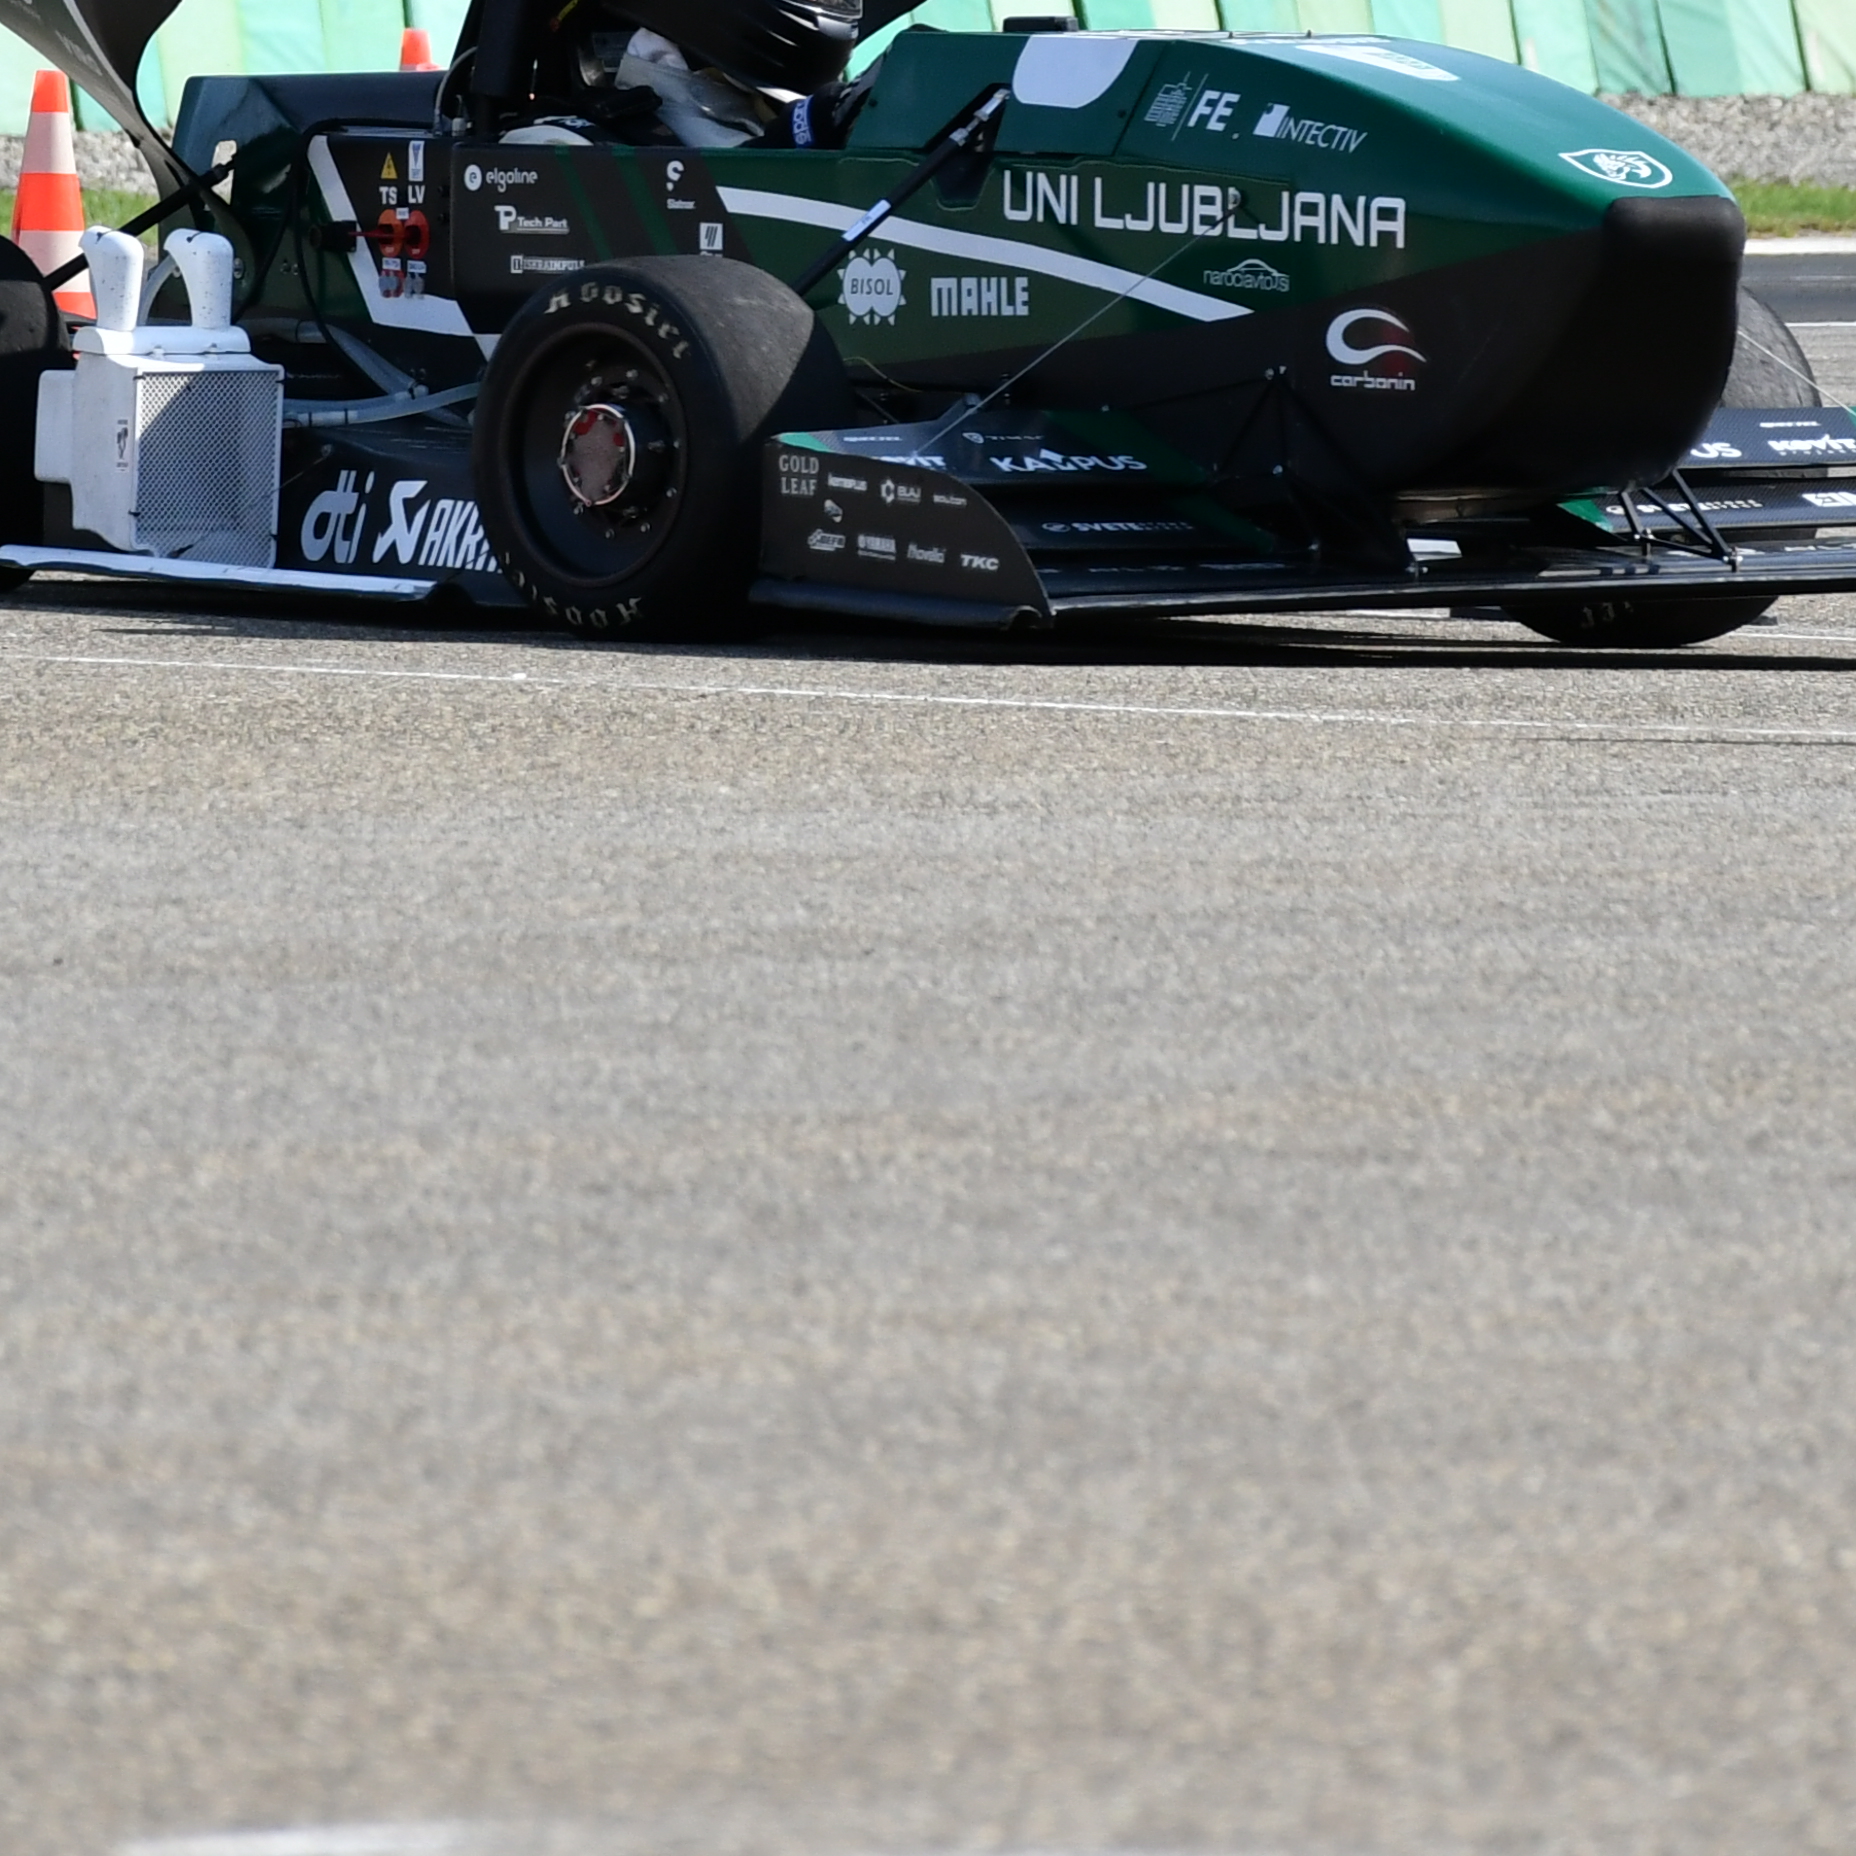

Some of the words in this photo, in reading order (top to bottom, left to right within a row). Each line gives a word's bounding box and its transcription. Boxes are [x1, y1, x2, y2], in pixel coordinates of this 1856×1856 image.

[1187, 89, 1242, 132] FE
[1276, 115, 1369, 154] INTECTIV
[485, 167, 539, 193] elgoline
[379, 186, 398, 205] TS
[407, 184, 425, 204] LV
[1002, 169, 1079, 227] UNI
[1093, 177, 1407, 249] LJUBLJANA
[517, 216, 543, 228] Tech
[544, 216, 568, 228] Part
[850, 277, 894, 296] BISOL
[930, 276, 1030, 318] MAHLE
[1330, 370, 1416, 391] carbonin
[778, 454, 820, 475] GOLD
[780, 476, 817, 496] LEAF
[300, 469, 376, 565] dti
[960, 553, 1000, 571] TKC
